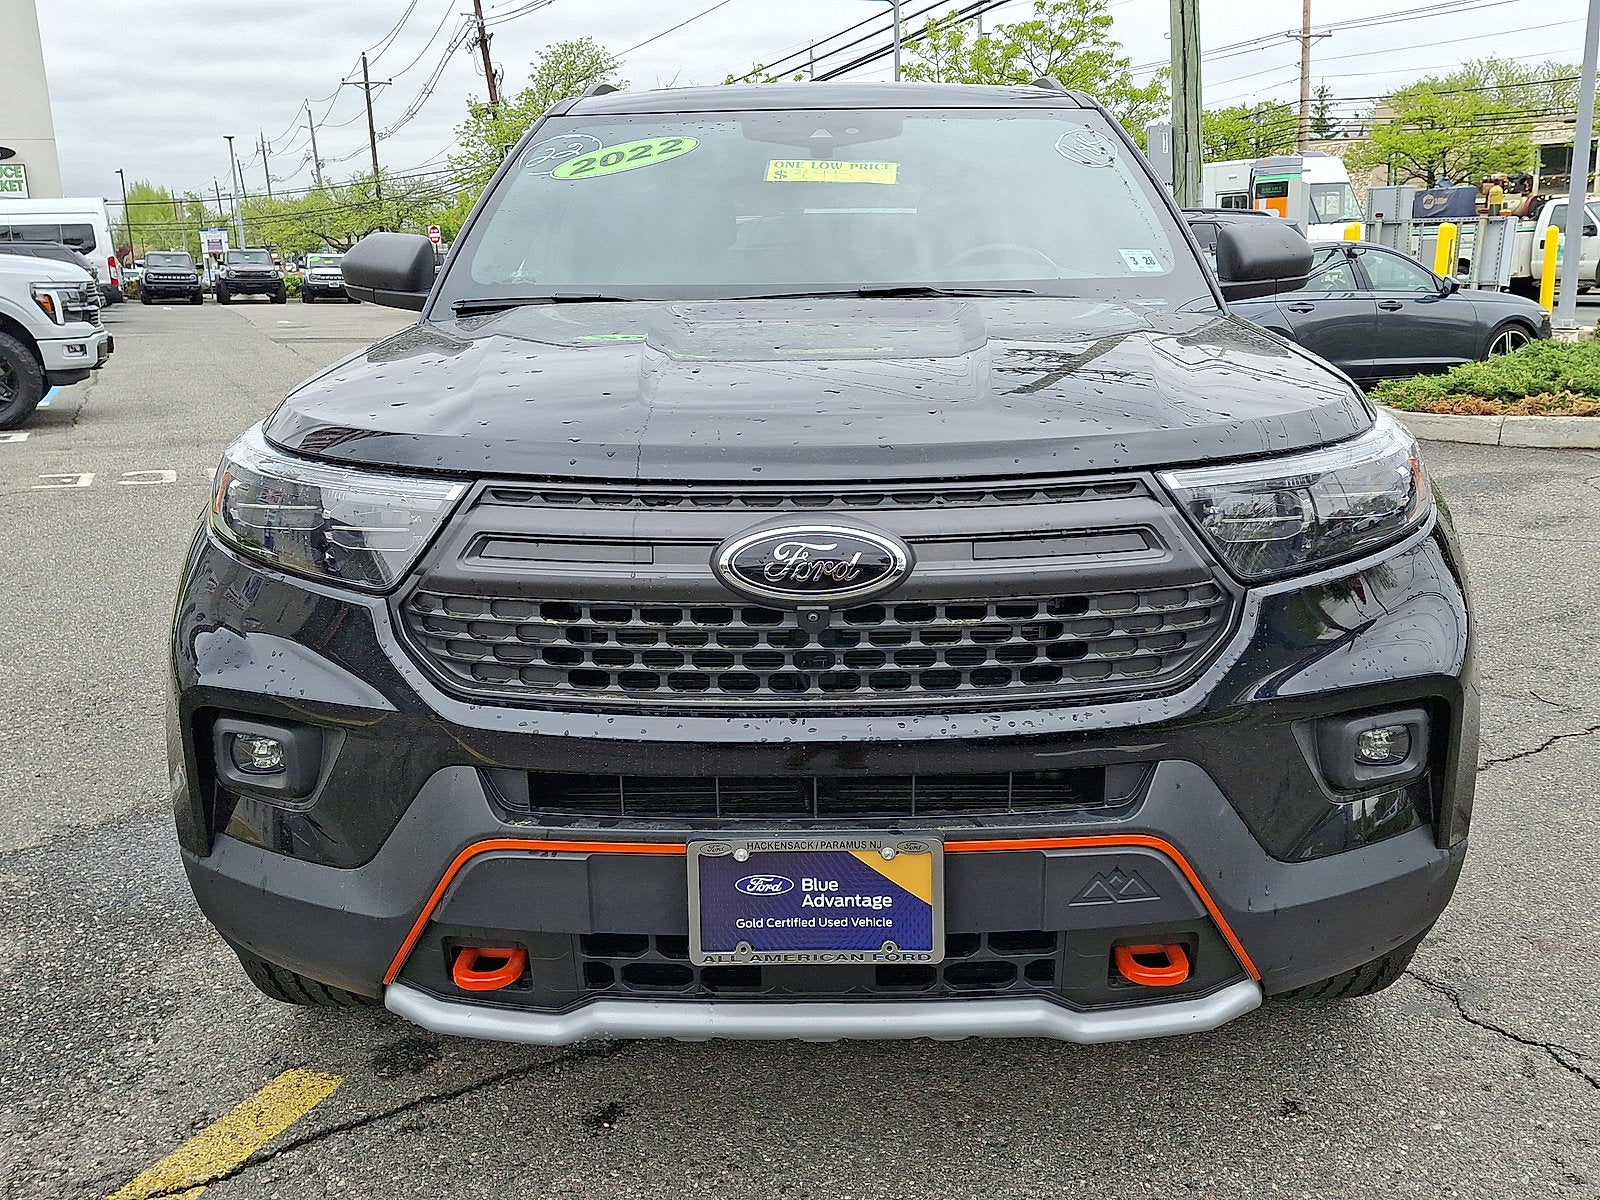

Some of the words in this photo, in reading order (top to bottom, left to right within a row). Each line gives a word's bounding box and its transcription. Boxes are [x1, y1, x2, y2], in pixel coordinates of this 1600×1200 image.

[569, 138, 683, 177] 2022
[773, 161, 805, 169] ONE
[811, 161, 843, 170] LOW
[1129, 256, 1139, 266] 3
[1141, 256, 1156, 266] 28
[763, 541, 863, 582] Ford
[869, 840, 882, 849] NJ
[746, 877, 783, 892] Ford
[801, 878, 839, 892] Blue
[801, 894, 893, 910] Advantage
[735, 918, 764, 929] Gold
[766, 917, 816, 928] Certified
[818, 917, 848, 928] Used
[850, 916, 893, 928] Vehicle
[702, 954, 743, 964] ALL
[749, 953, 865, 963] AMERICAN
[872, 952, 932, 962] FORD
